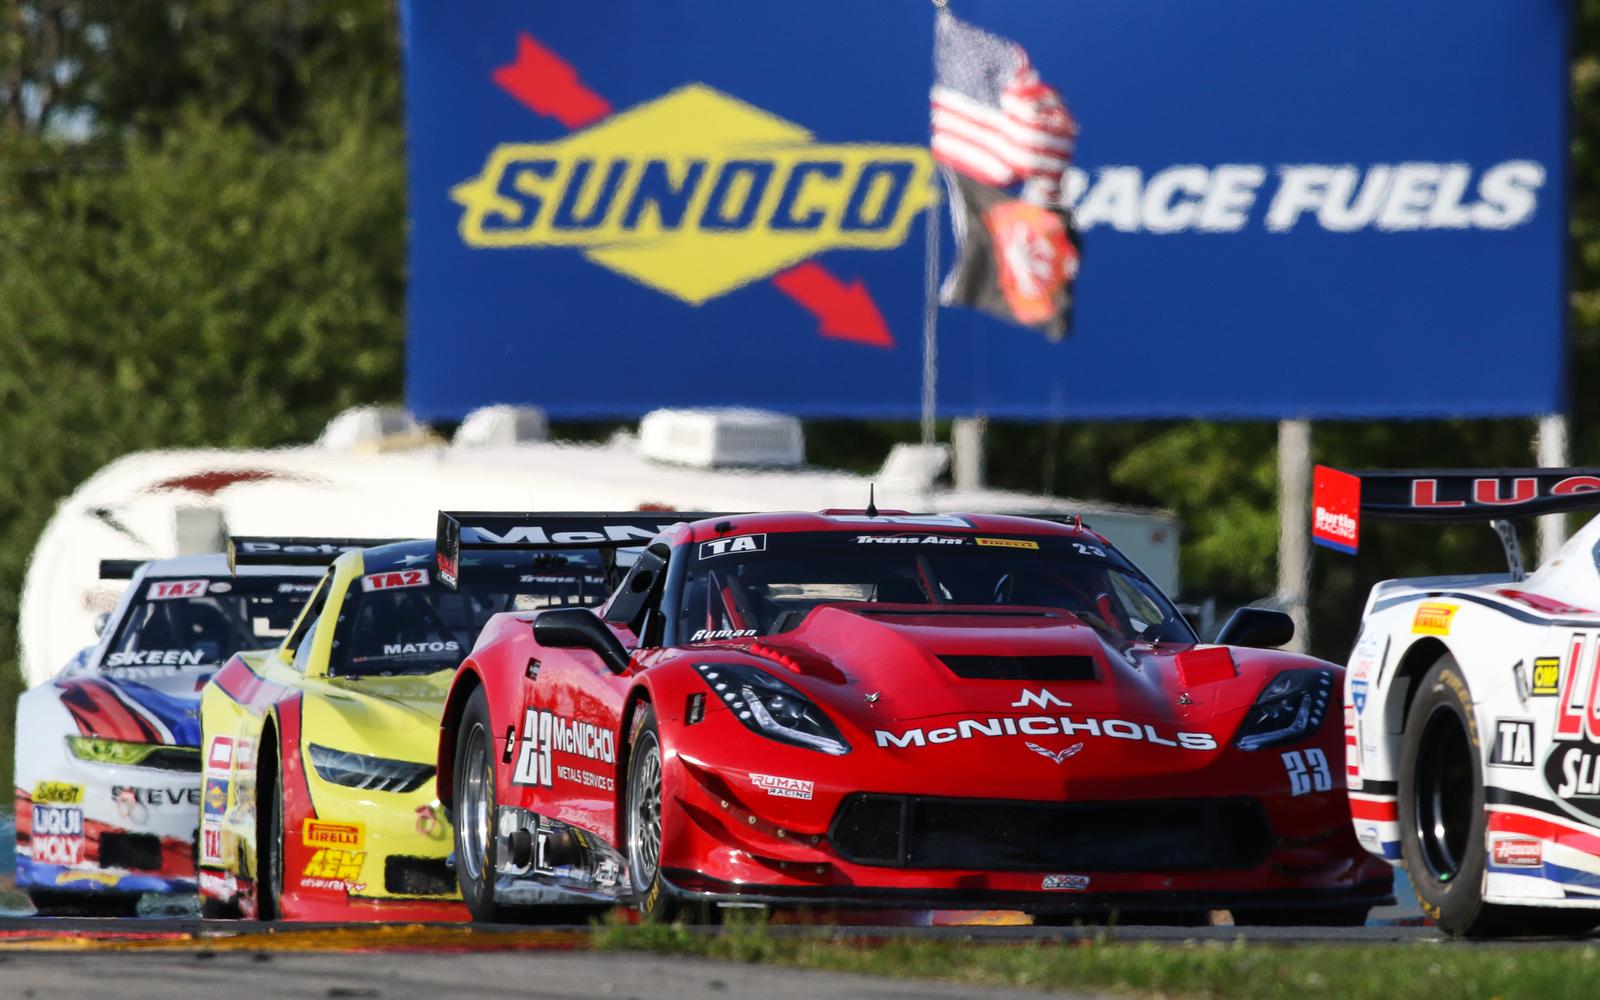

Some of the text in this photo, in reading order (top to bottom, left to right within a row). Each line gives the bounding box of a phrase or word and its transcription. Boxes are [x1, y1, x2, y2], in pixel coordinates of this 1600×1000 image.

[480, 159, 918, 232] SUNOCO
[1265, 159, 1546, 232] FUELS
[707, 537, 757, 555] TA
[857, 535, 963, 545] Trans Am
[1072, 543, 1107, 557] 23
[369, 571, 422, 588] TA2
[157, 583, 202, 599] TA2
[690, 628, 758, 641] Ruman
[384, 641, 459, 655] MATOS
[108, 650, 204, 667] SKEEN
[874, 715, 1218, 750] McNICHOLS
[512, 706, 553, 789] 23
[1499, 723, 1534, 764] TA
[557, 765, 582, 783] METALS
[582, 769, 606, 791] SERVICE
[1281, 748, 1333, 797] 23
[752, 775, 812, 791] RUMAN
[769, 788, 811, 799] RACING
[33, 806, 82, 834] LIQUI
[308, 823, 358, 844] PIRELLI
[33, 835, 83, 864] MOLY
